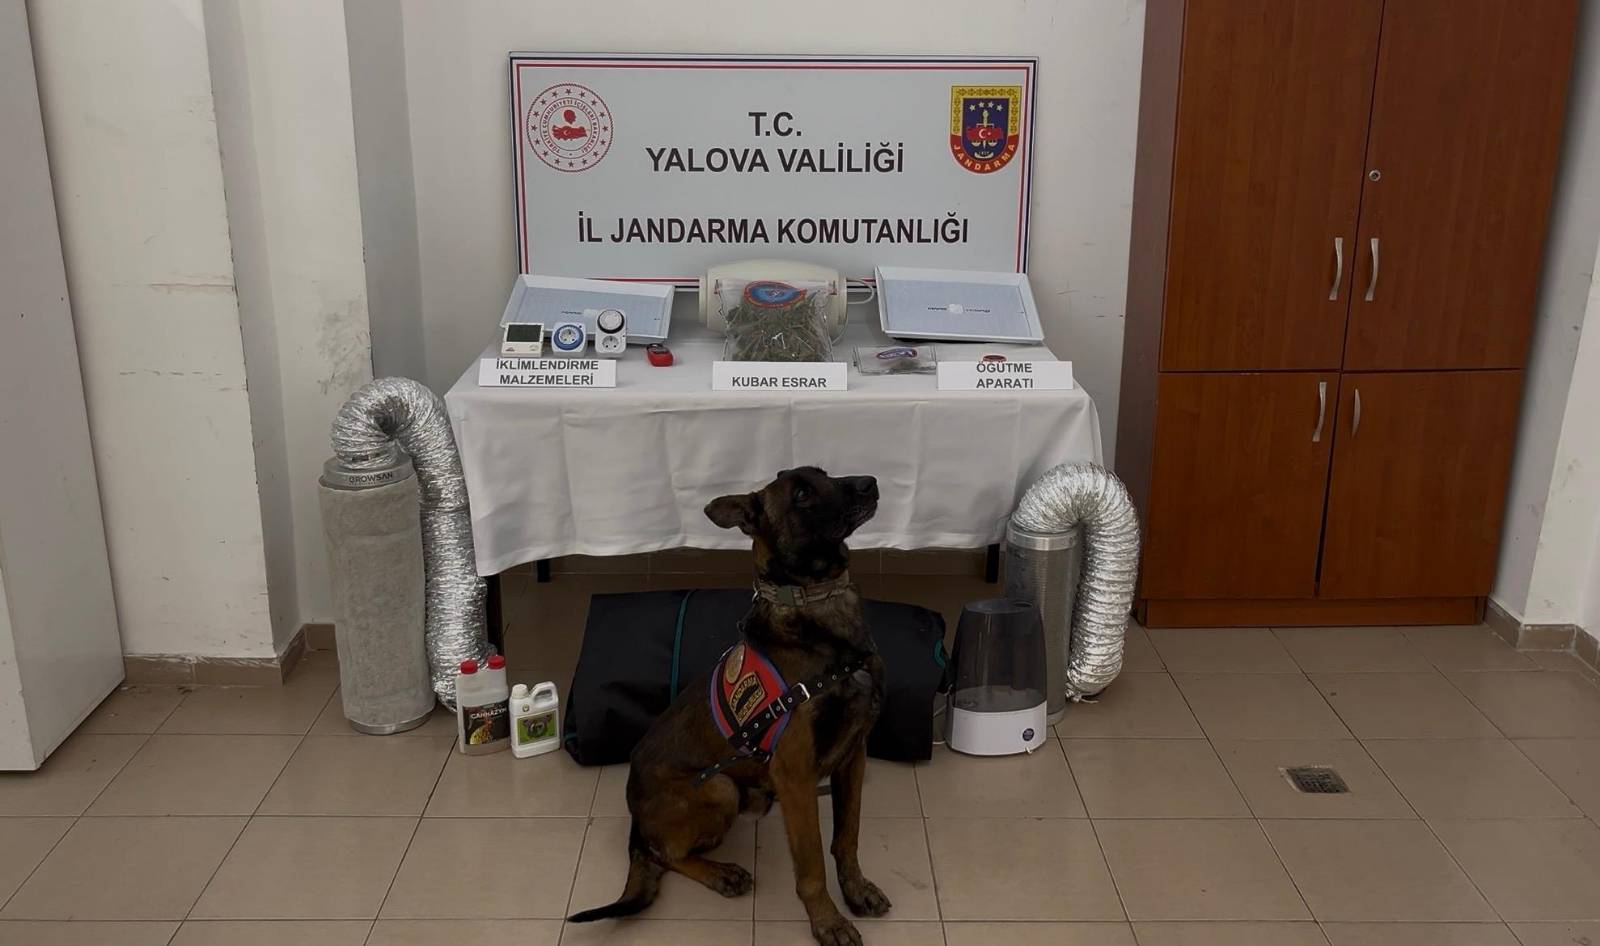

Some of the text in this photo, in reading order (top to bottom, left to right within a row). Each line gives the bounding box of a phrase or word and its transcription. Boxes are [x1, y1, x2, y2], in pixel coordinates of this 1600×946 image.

[748, 111, 802, 137] T.C.
[645, 142, 904, 173] YALOVA VALİLİĞİ
[953, 144, 1016, 171] JANDARMA
[578, 211, 968, 244] İL JANDARMA KOMUTANLIĞI
[496, 358, 599, 370] İKLİMLENDİRME
[499, 373, 593, 386] MALZEMELERİ
[732, 376, 827, 388] KUBAR ESRAR
[976, 378, 1033, 389] APARATI
[349, 471, 393, 483] GROWSAN
